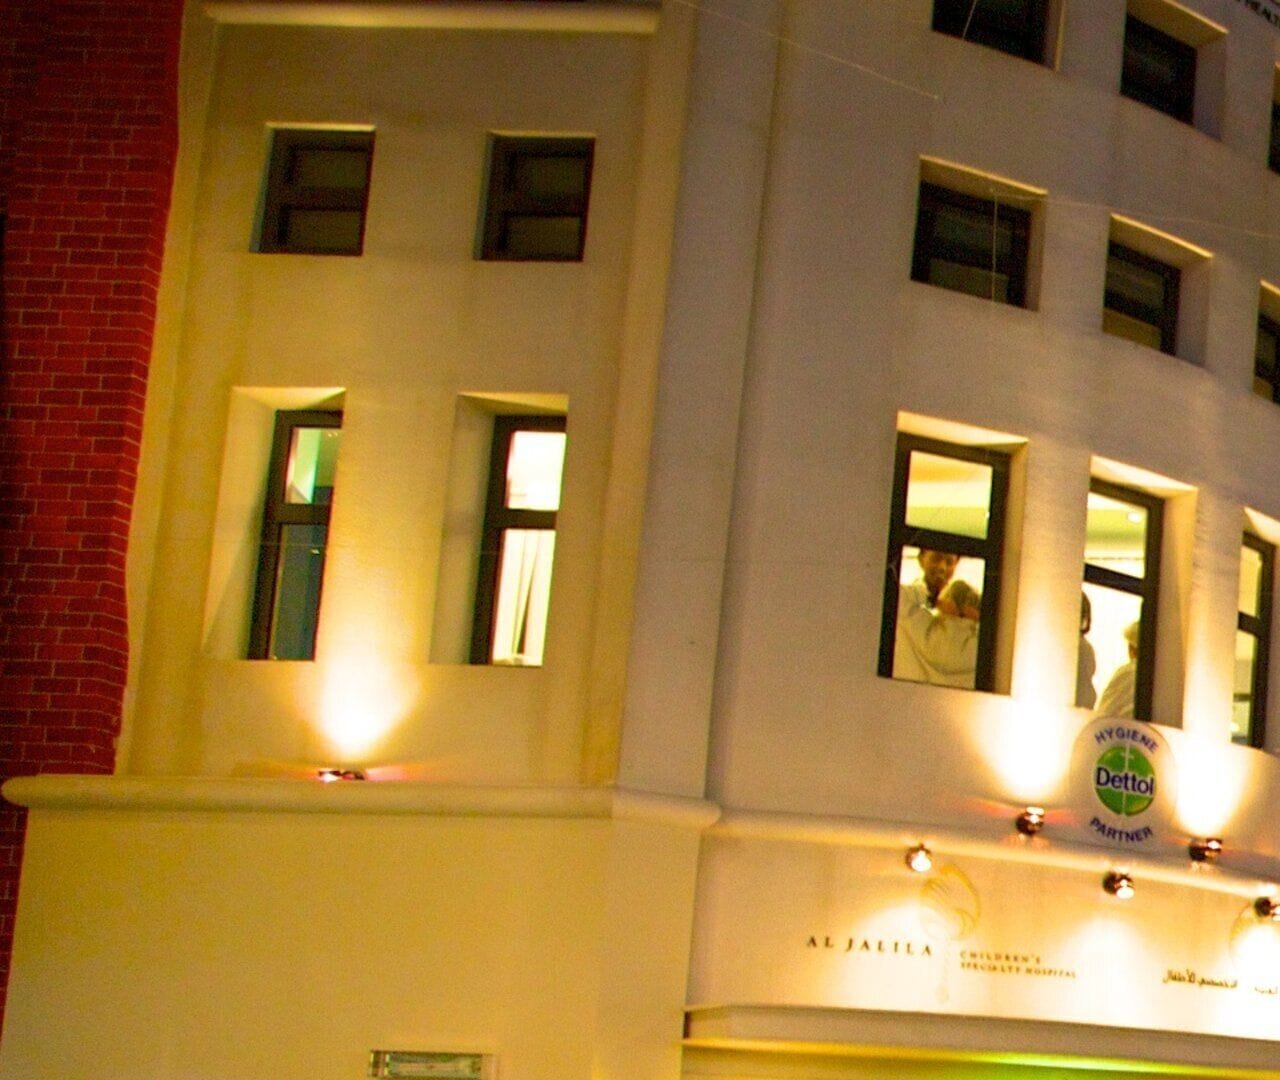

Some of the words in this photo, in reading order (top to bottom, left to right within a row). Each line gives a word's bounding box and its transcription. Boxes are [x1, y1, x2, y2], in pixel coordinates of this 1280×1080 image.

[1094, 726, 1158, 753] HYGIENE
[1096, 767, 1154, 795] Dettol
[1089, 817, 1153, 842] PARTNER
[806, 936, 834, 949] AL
[845, 938, 933, 956] JALILA
